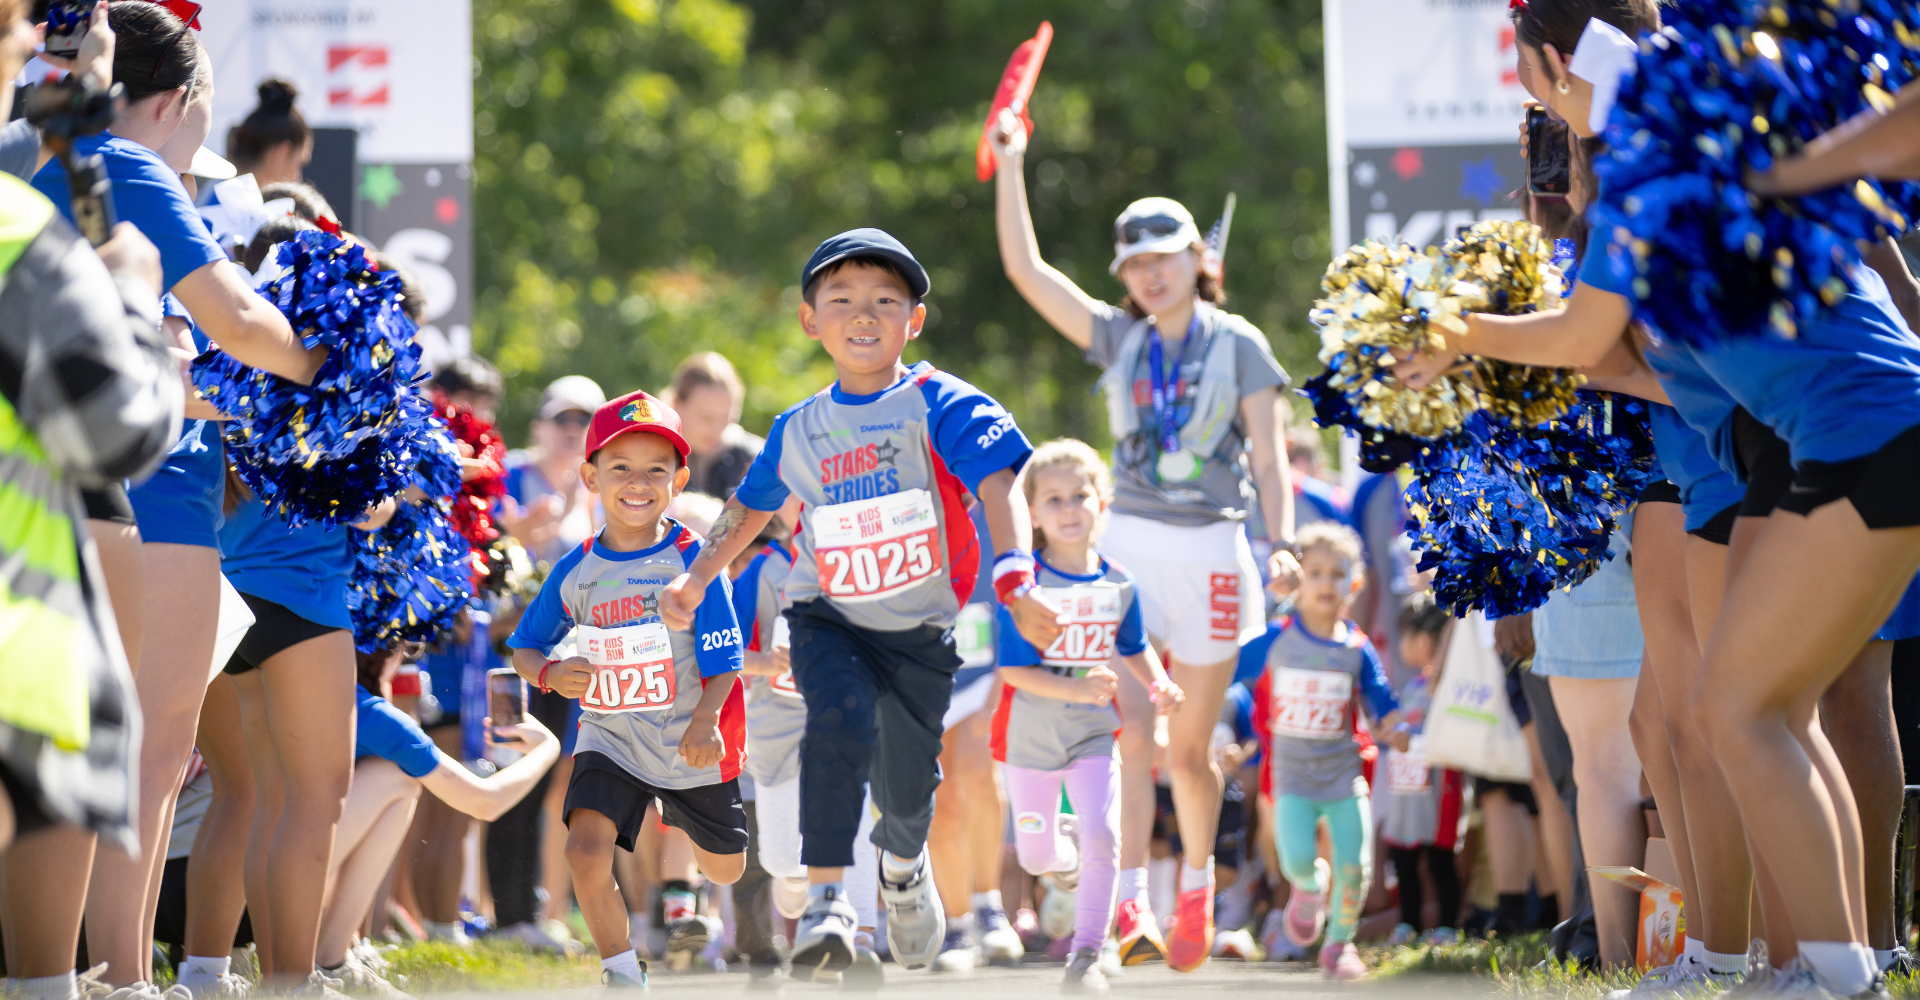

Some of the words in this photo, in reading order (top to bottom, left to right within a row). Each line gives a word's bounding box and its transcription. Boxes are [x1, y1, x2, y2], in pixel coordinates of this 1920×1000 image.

[860, 423, 895, 433] TARANA
[820, 443, 878, 484] STARS
[822, 467, 899, 506] STRIDES
[857, 506, 881, 525] KIDS
[860, 521, 883, 539] RUN
[824, 533, 934, 595] 2025
[591, 594, 644, 628] STARS
[645, 599, 657, 608] AND
[604, 636, 623, 649] KIDS
[606, 648, 624, 661] RUN
[701, 629, 741, 651] 2025
[1044, 624, 1117, 659] 2025
[584, 664, 669, 708] 2025
[1275, 699, 1344, 730] 2025
